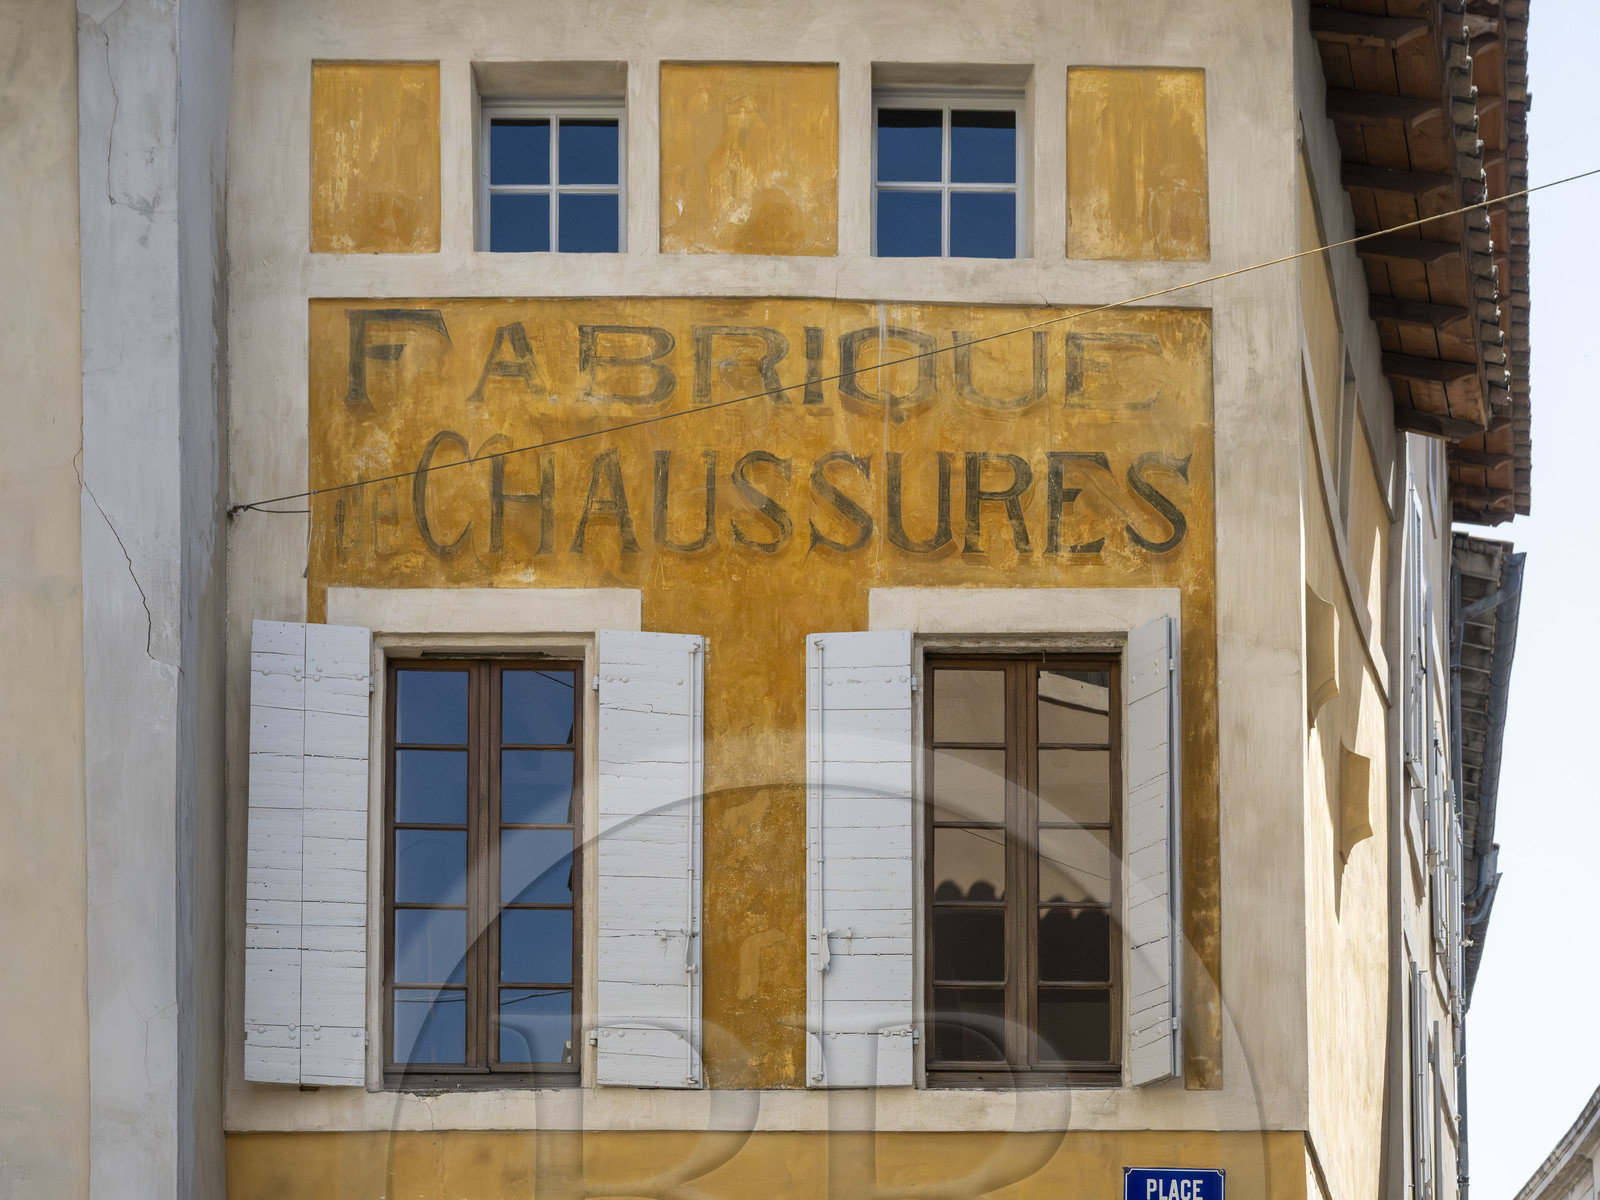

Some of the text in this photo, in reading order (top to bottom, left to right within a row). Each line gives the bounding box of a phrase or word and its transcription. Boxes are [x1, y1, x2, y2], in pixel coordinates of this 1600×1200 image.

[344, 307, 1163, 424] FABRIQUE
[411, 430, 1193, 558] CHAUSSURES
[1146, 1178, 1204, 1200] PLACE
